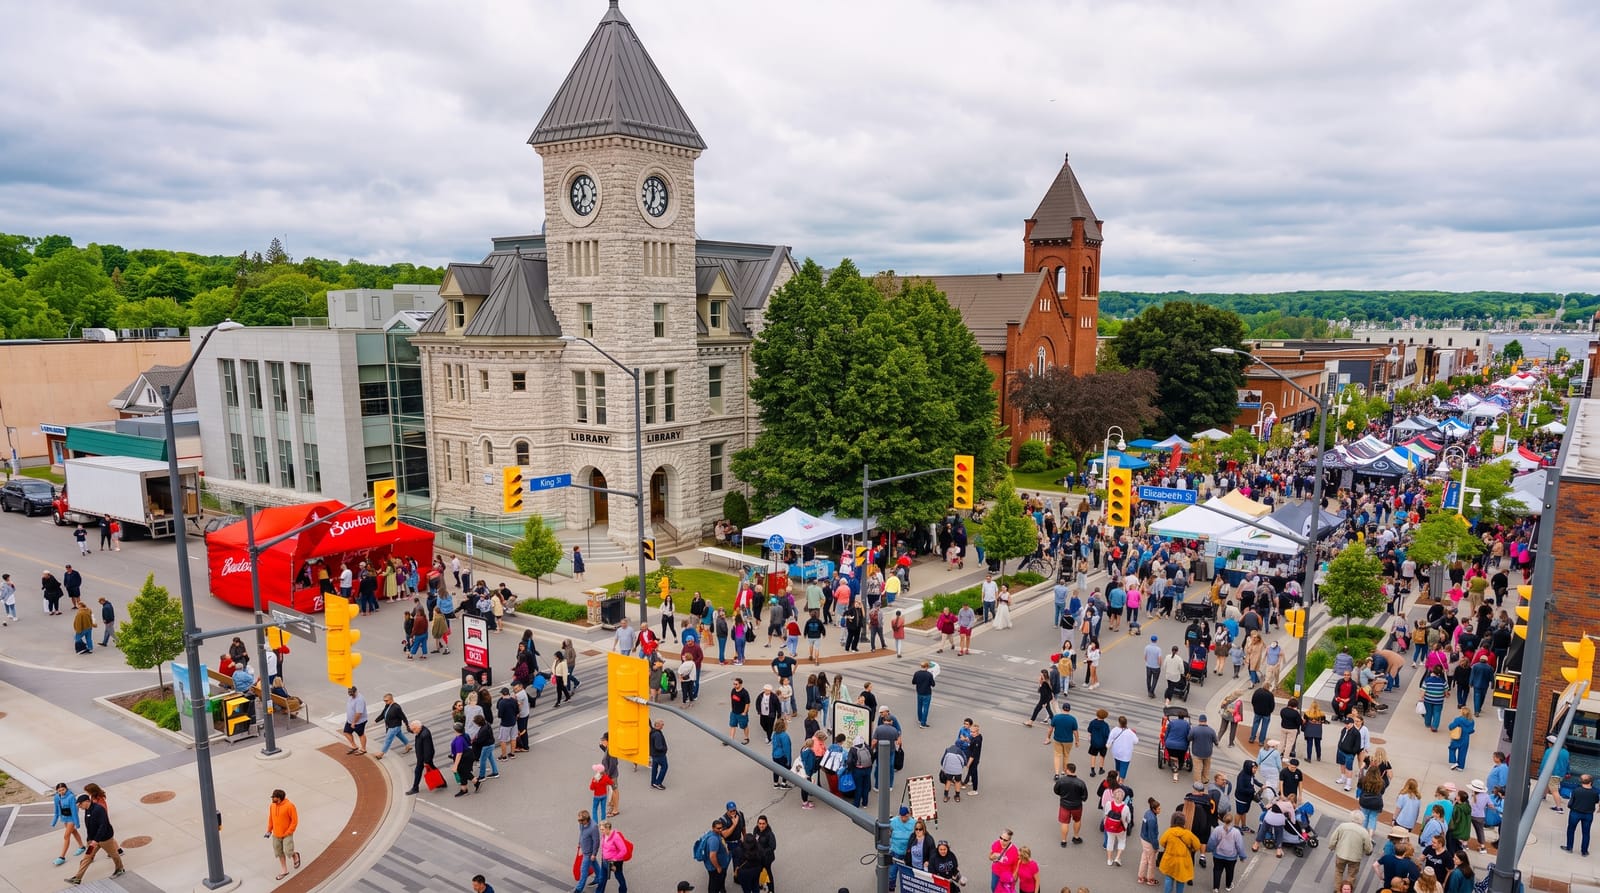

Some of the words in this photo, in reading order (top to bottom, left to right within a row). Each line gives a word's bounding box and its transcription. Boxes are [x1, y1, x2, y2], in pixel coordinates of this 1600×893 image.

[571, 432, 610, 444] LIBRARY
[647, 431, 681, 443] LIBRARY
[540, 479, 555, 488] King
[1143, 488, 1183, 500] Elizabeth
[1185, 492, 1193, 501] St
